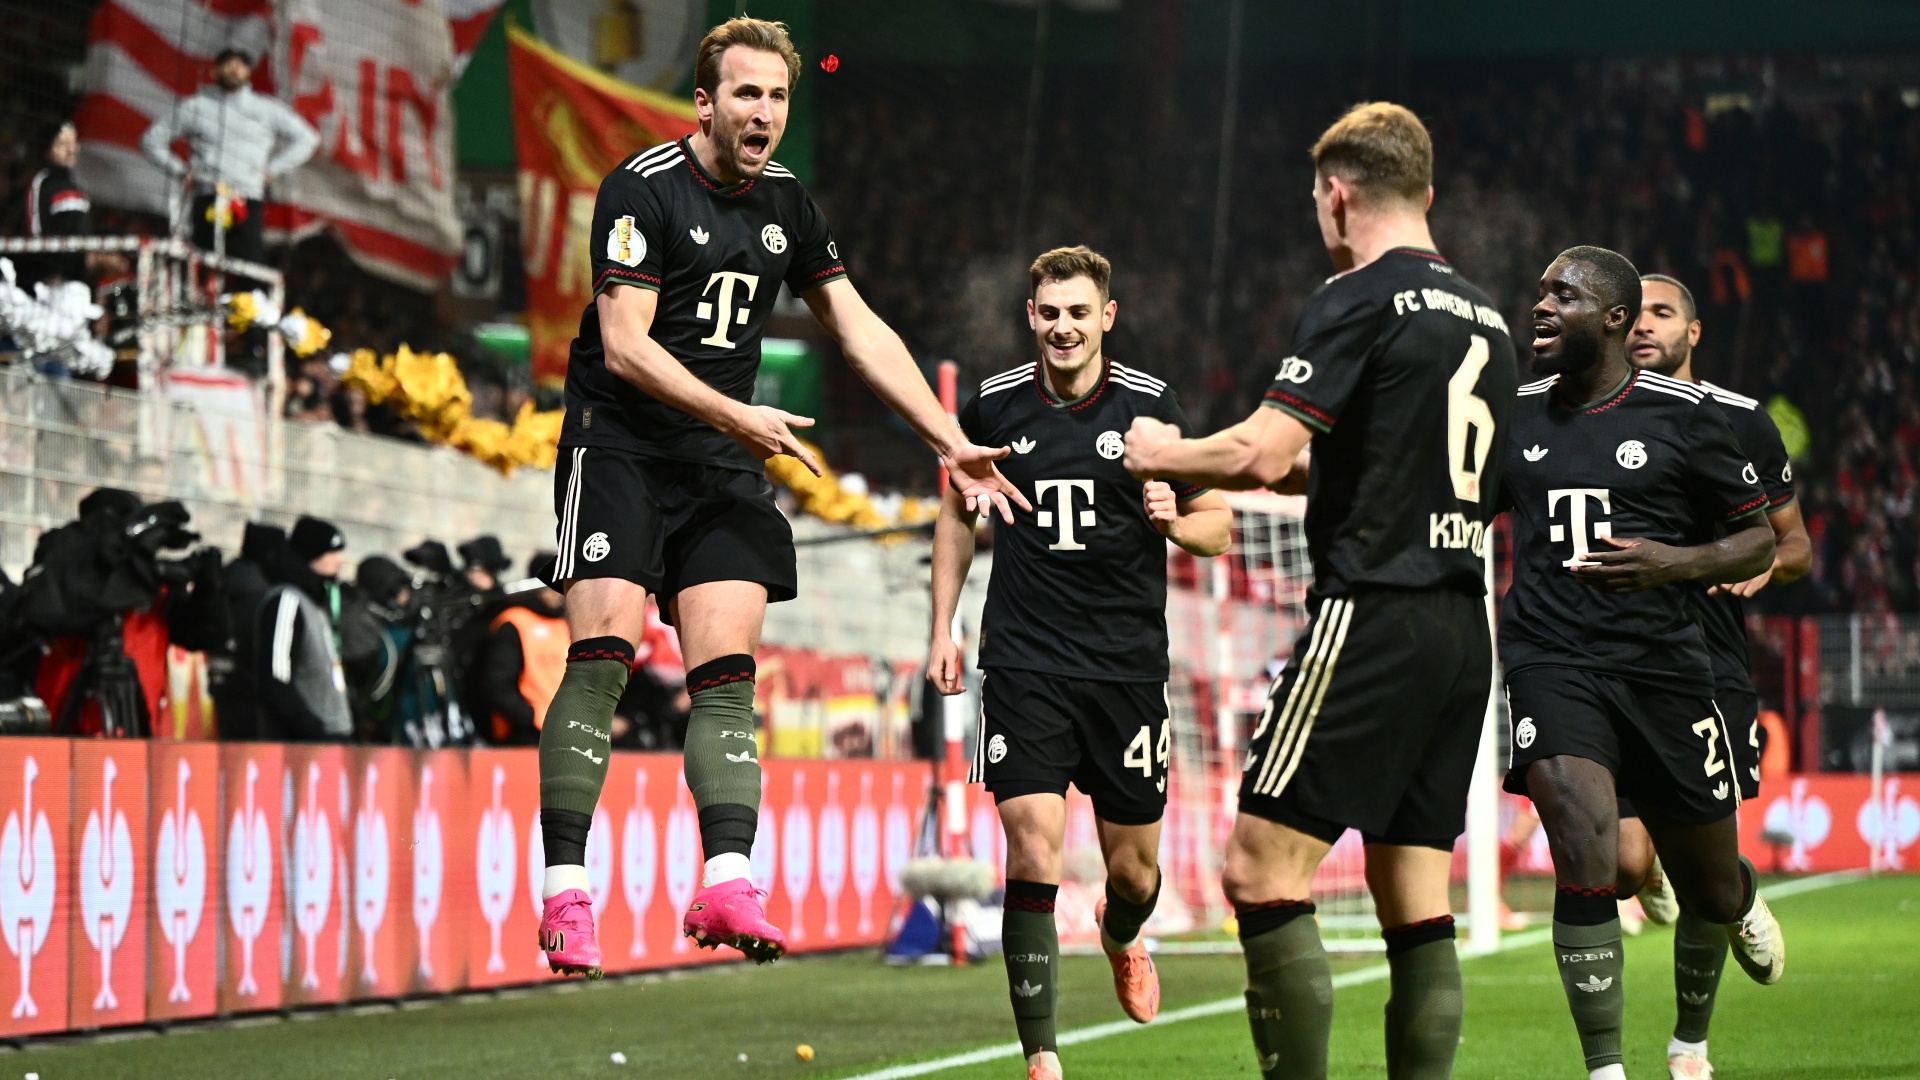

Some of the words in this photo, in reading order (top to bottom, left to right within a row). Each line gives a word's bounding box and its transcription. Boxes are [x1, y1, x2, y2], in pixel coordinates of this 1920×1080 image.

[1394, 290, 1421, 316] FC
[1421, 288, 1474, 321] BAYERN
[1448, 334, 1495, 503] 6
[1692, 716, 1725, 778] 2
[1561, 951, 1614, 964] FCBM
